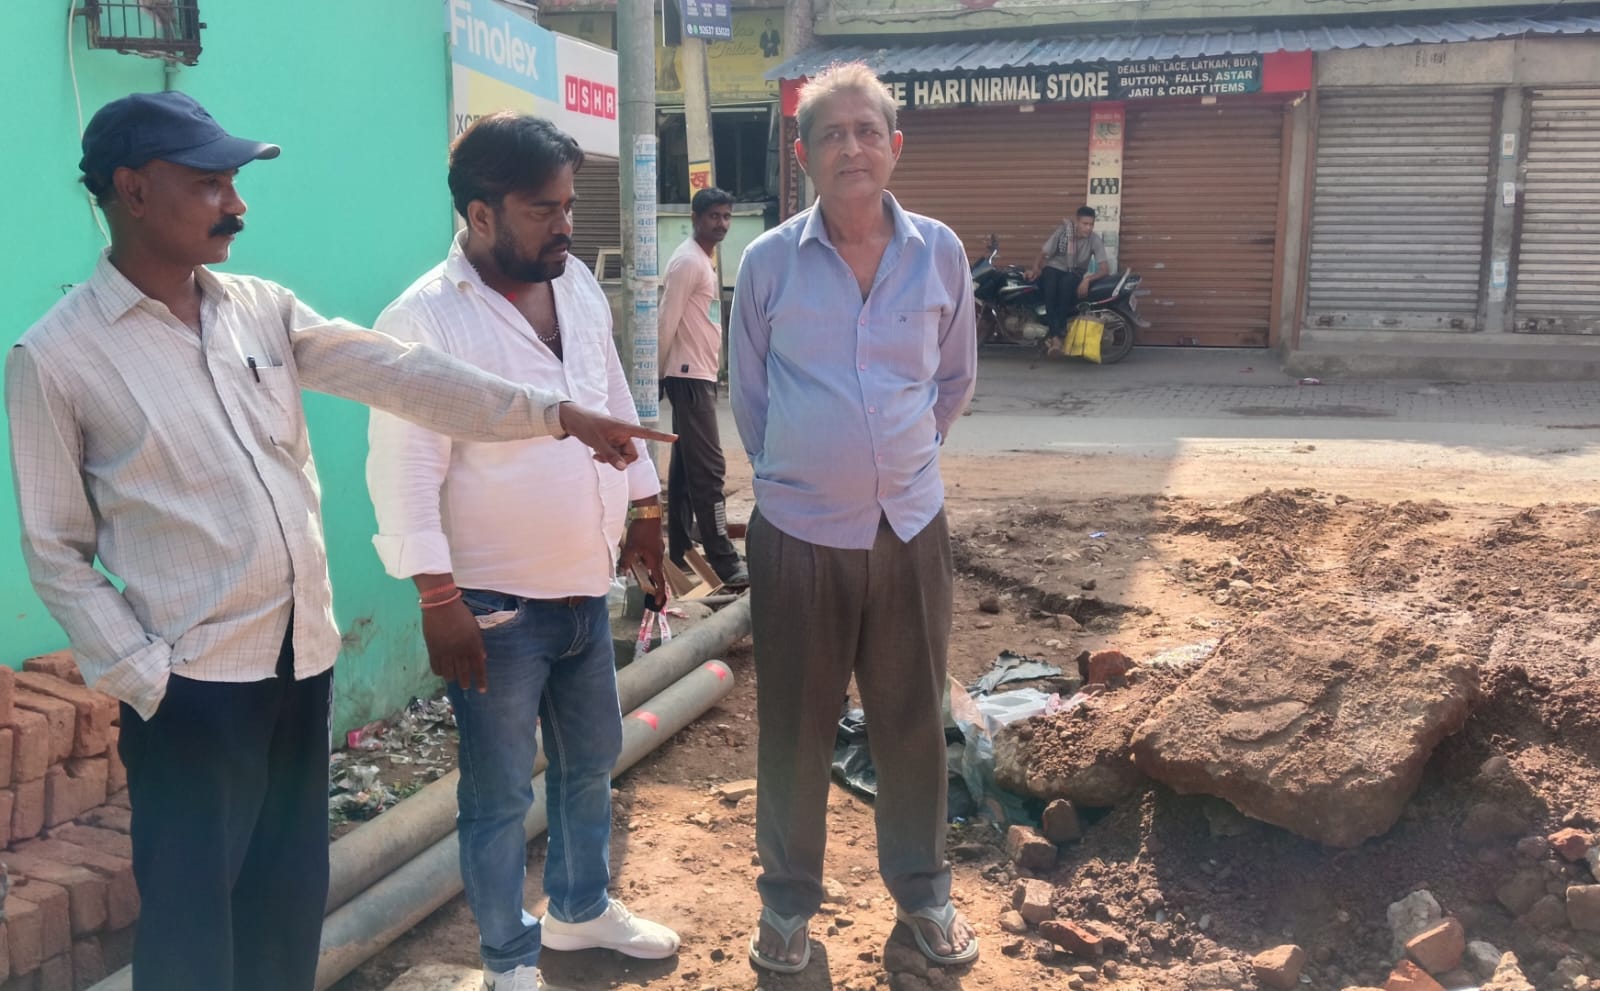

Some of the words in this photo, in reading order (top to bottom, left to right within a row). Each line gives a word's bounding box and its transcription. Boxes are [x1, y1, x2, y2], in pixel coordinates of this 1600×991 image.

[450, 0, 539, 81] Finolex
[1117, 63, 1146, 75] DEALS
[1148, 62, 1161, 73] IN:
[1163, 61, 1190, 73] LACE,
[1191, 59, 1231, 71] LATKAN,
[914, 78, 966, 105] HARI
[970, 75, 1041, 103] NIRMAL
[1046, 71, 1109, 100] STORE
[1120, 74, 1169, 87] BUTTON,
[1175, 72, 1213, 84] FALLS,
[1215, 70, 1253, 81] ASTAR
[567, 80, 614, 115] USHA
[1128, 87, 1154, 98] JARI
[1157, 86, 1165, 96] &
[1168, 84, 1207, 95] CRAFT
[1209, 82, 1245, 93] ITEMS
[456, 114, 480, 136] XC
